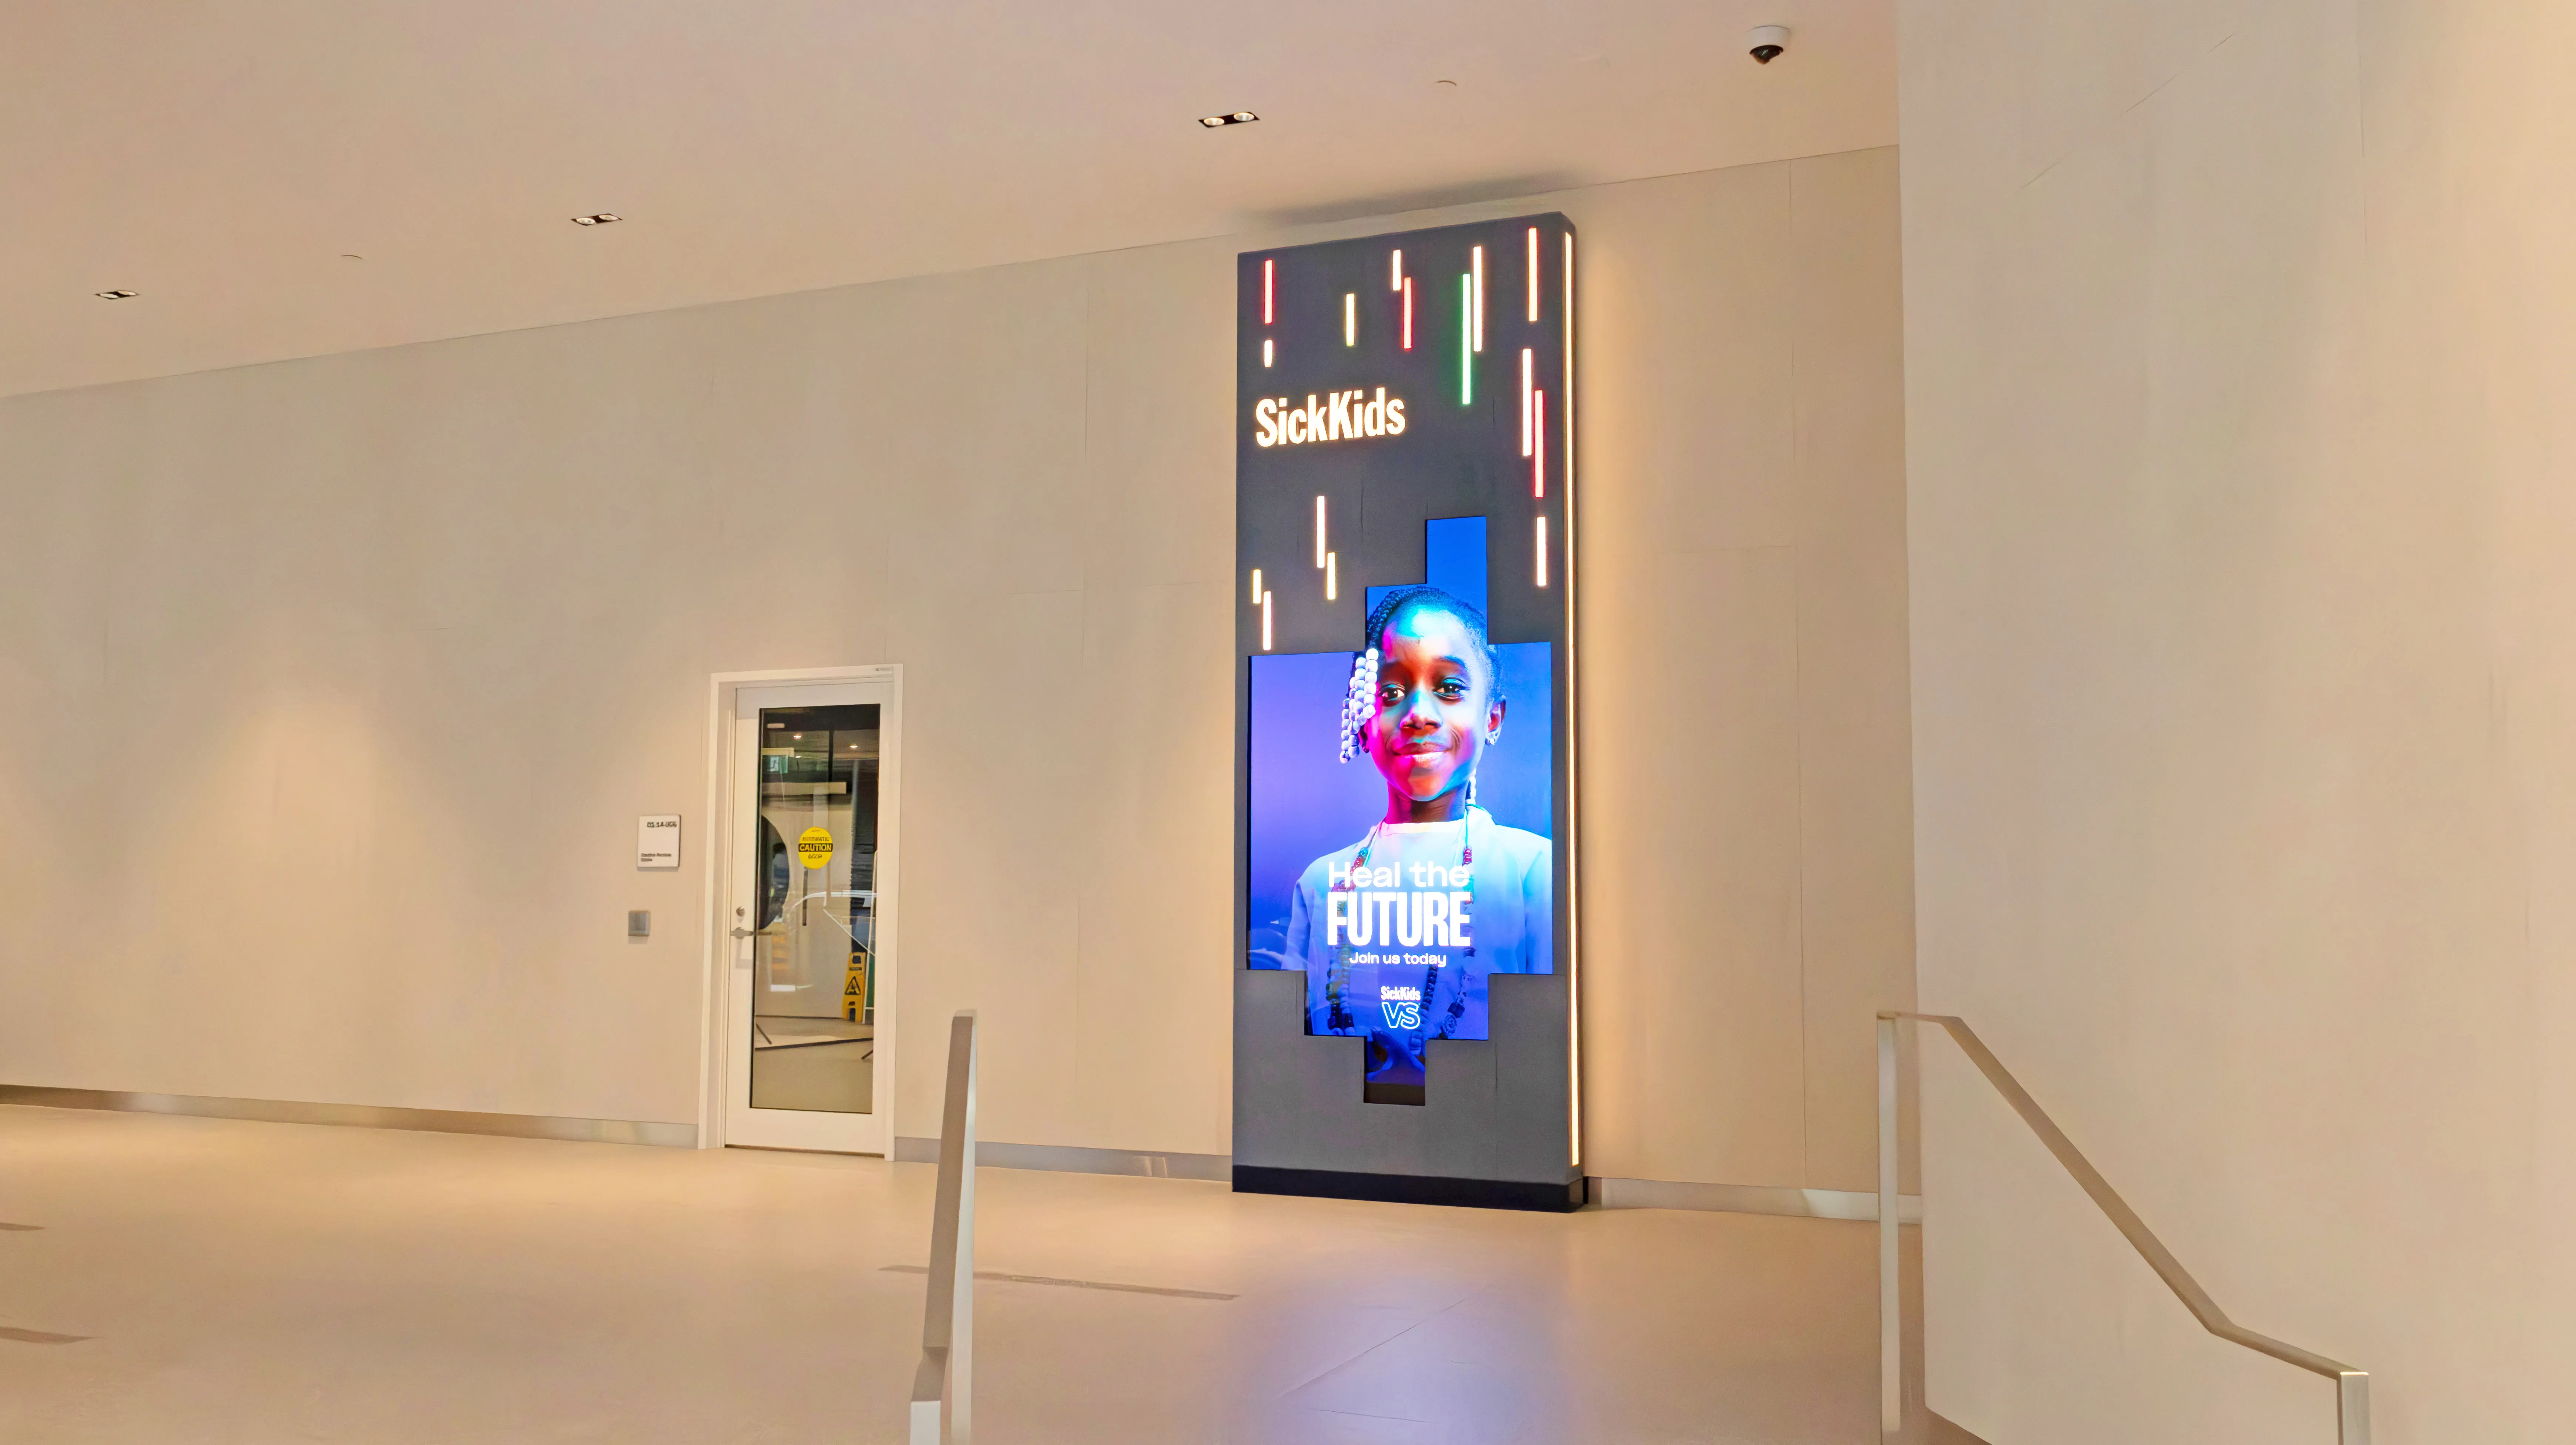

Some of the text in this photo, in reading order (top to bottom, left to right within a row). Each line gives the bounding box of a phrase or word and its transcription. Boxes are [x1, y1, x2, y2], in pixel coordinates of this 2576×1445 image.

[1256, 387, 1406, 447] SickKids
[1329, 861, 1469, 887] Heal the
[1327, 892, 1470, 946] FUTURE
[1349, 952, 1446, 967] Join us today
[1381, 986, 1421, 1000] SickKids
[1381, 1002, 1420, 1029] VS
